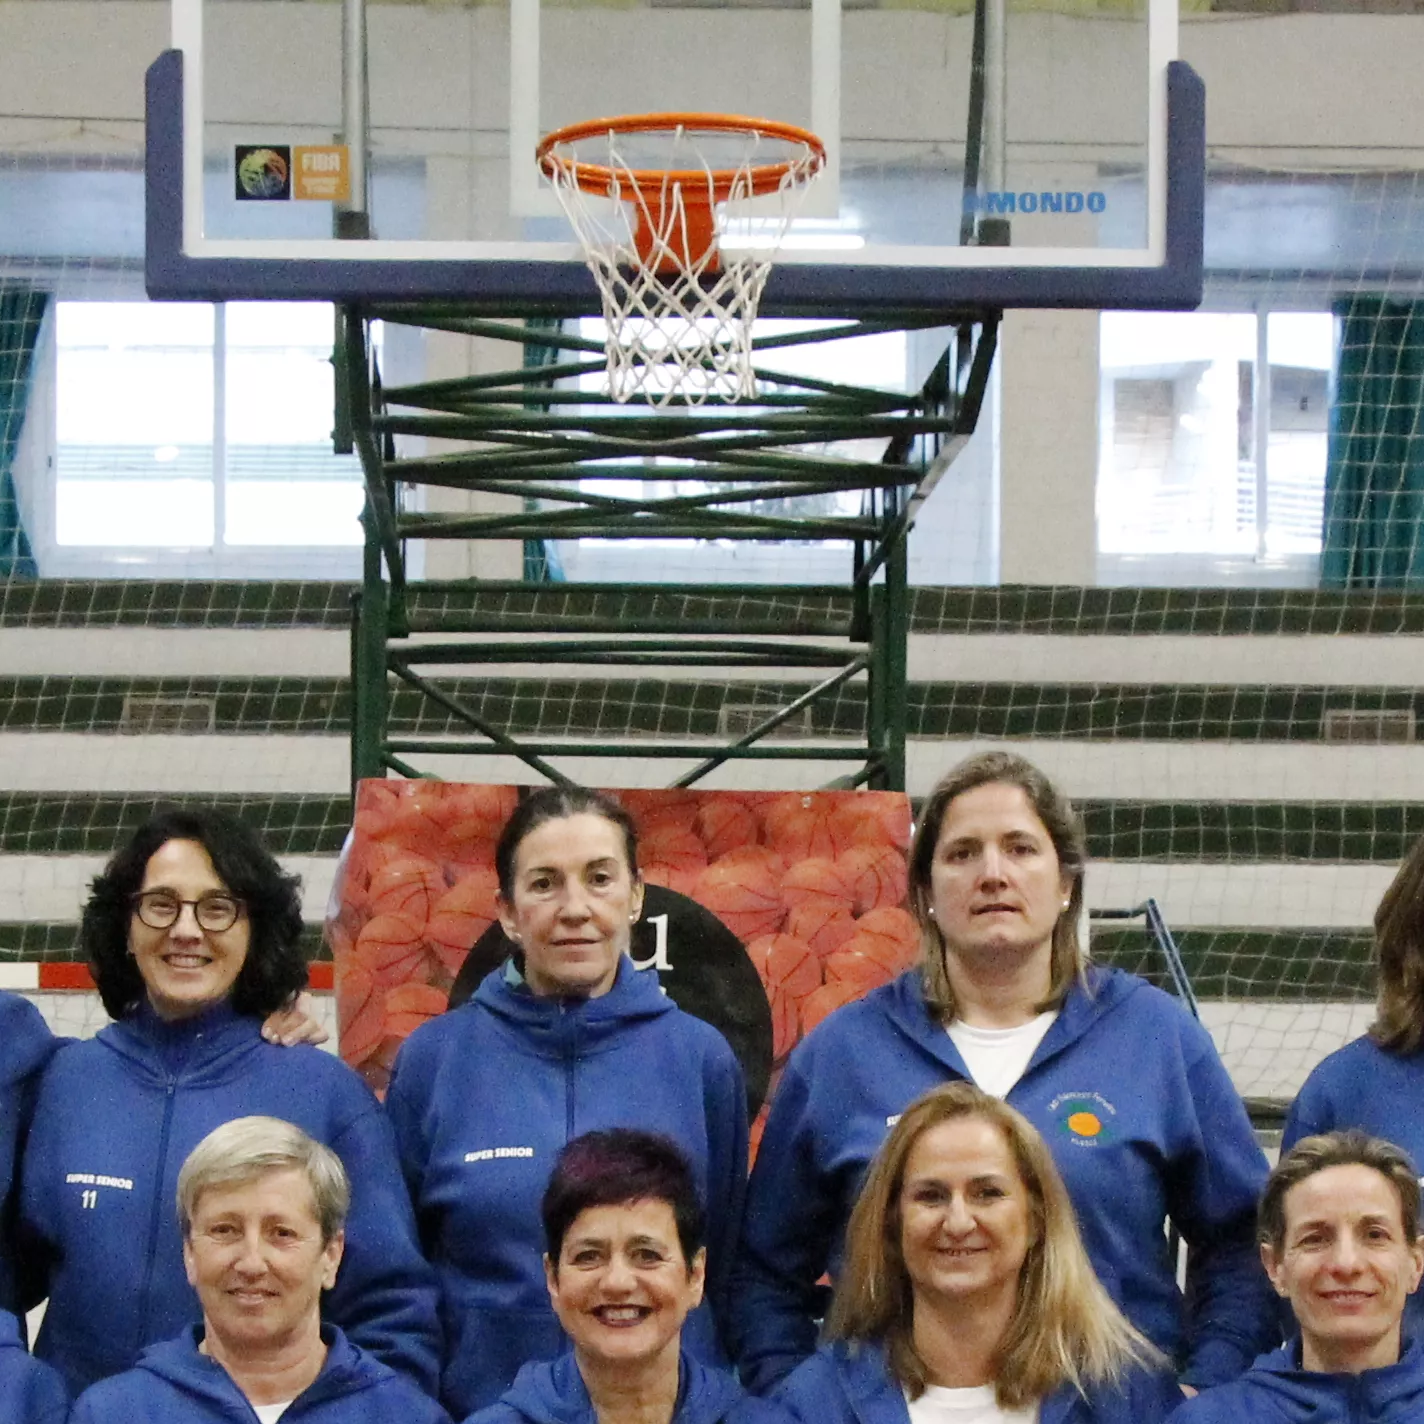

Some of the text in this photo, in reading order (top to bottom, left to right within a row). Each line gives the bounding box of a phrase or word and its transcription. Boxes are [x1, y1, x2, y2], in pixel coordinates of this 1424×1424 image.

[986, 191, 1106, 214] MONDO
[464, 1146, 534, 1162] SUPER SENIOR
[65, 1173, 134, 1190] SUPER SENIOR
[81, 1189, 97, 1210] 11
